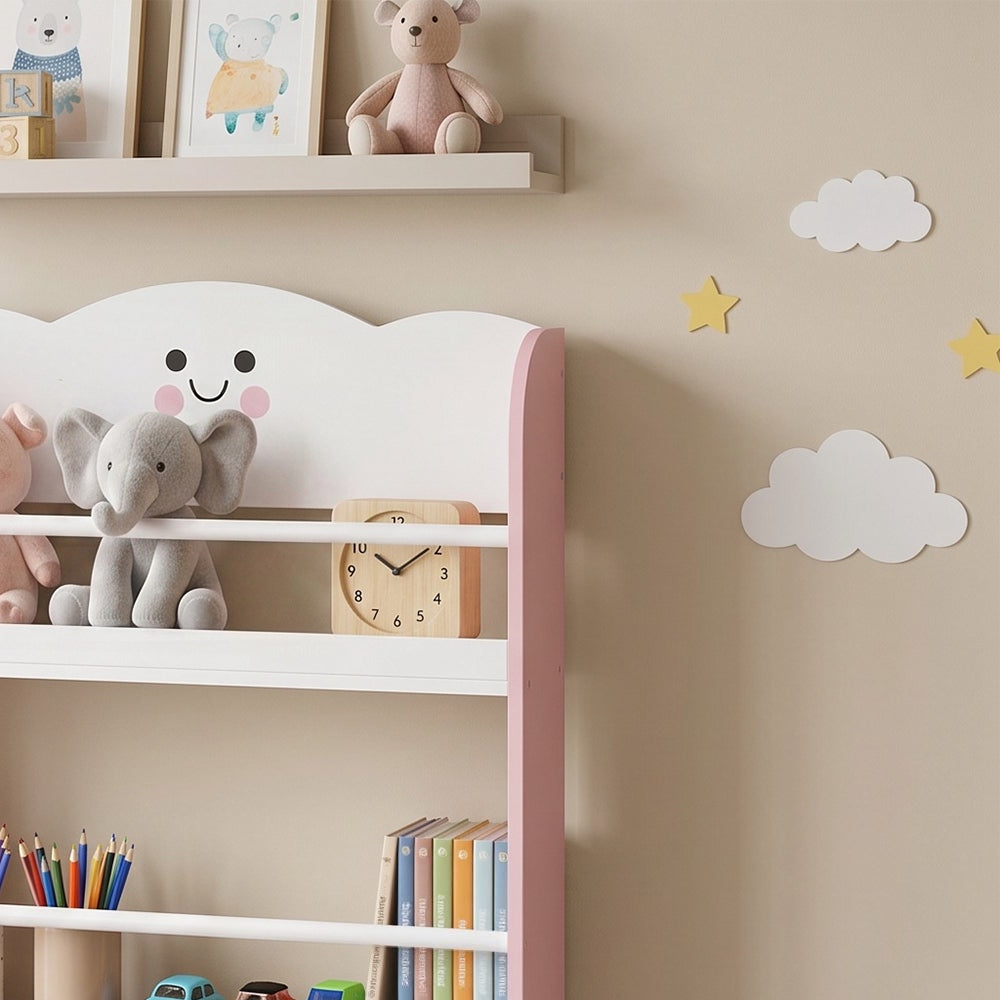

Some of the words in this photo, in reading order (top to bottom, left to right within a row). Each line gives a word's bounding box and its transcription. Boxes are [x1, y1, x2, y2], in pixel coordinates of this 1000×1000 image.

[352, 543, 367, 554] 10
[433, 545, 443, 555] 2
[347, 565, 356, 577] 9
[440, 567, 448, 580] 3
[354, 590, 363, 602] 8
[433, 593, 442, 605] 4
[371, 608, 379, 620] 7
[416, 610, 424, 622] 5
[393, 615, 401, 628] 6
